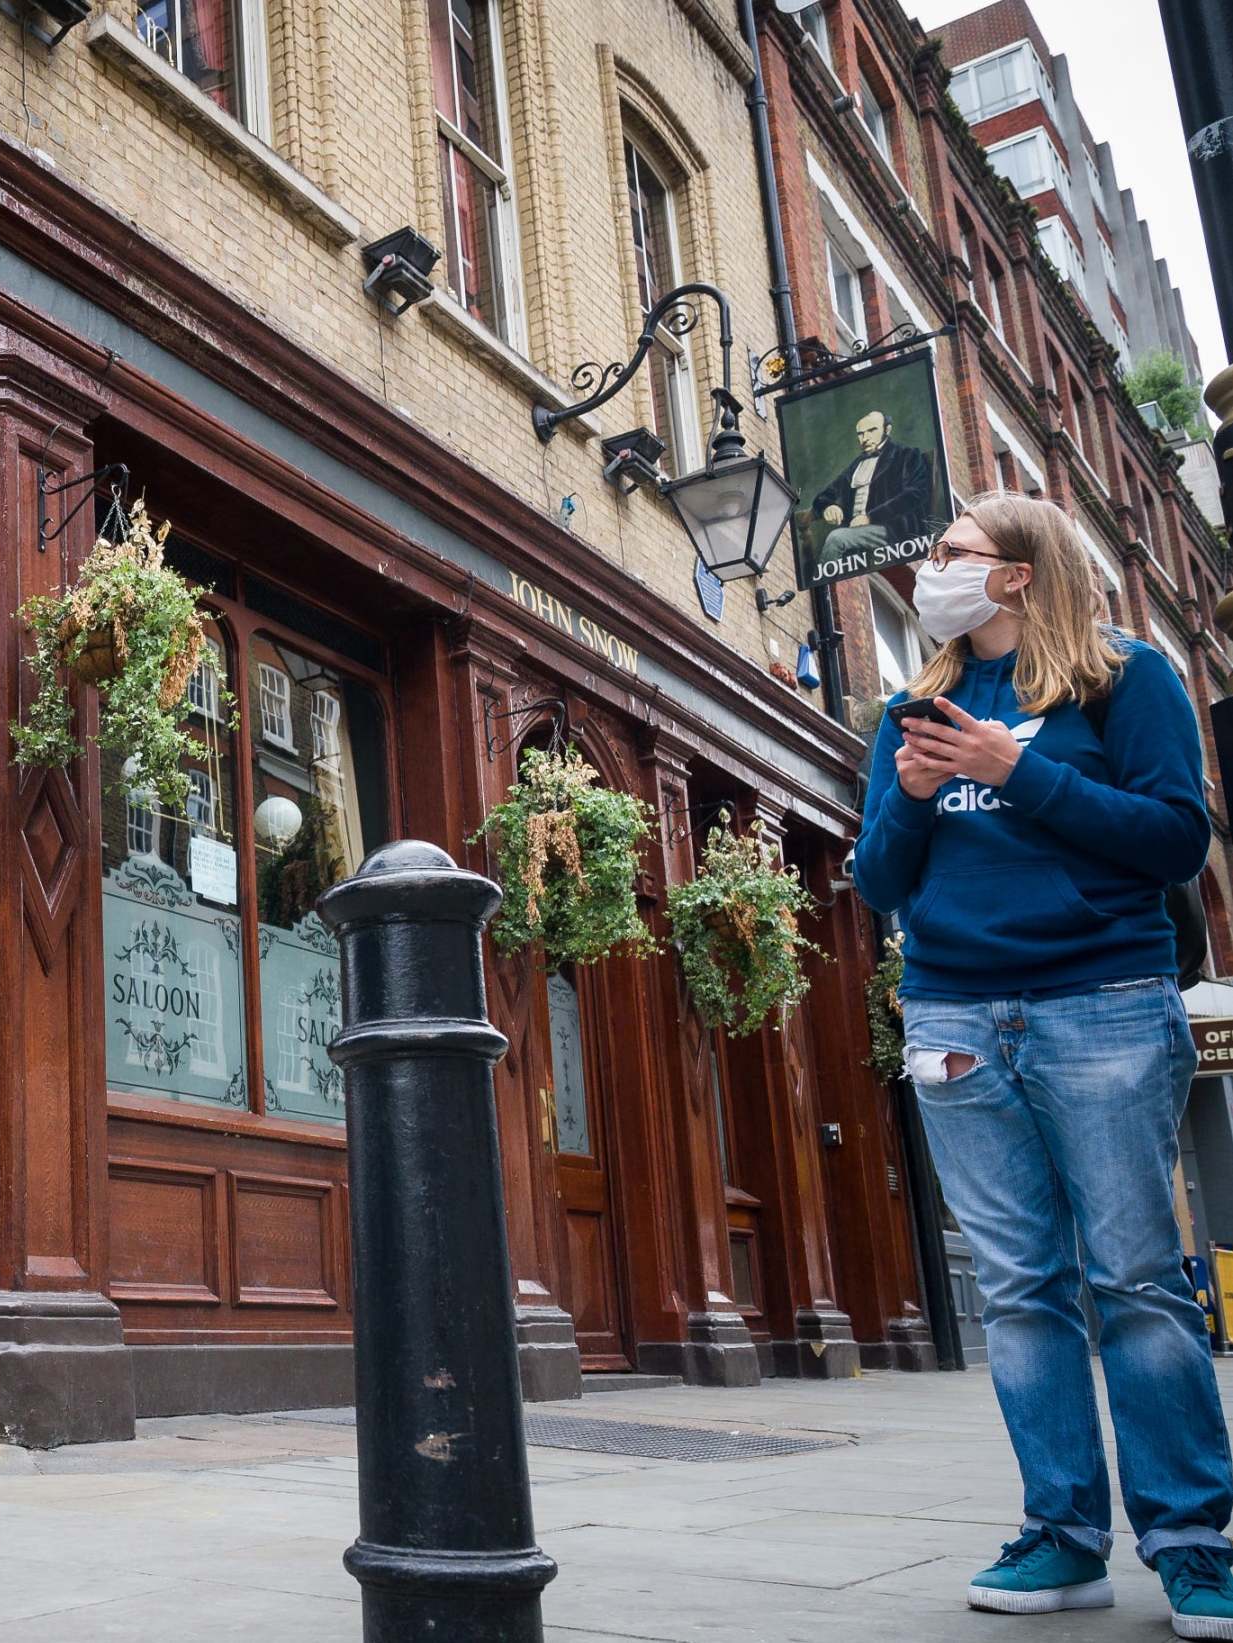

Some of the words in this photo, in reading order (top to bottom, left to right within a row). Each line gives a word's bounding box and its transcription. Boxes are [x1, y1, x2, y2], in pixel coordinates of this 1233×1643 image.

[813, 552, 868, 581] JOHN
[873, 533, 936, 565] SNOW
[509, 571, 573, 635] JOHN
[579, 616, 639, 674] SNOW
[935, 783, 1014, 816] dia
[112, 973, 201, 1020] SALOON
[1205, 1030, 1233, 1043] OF
